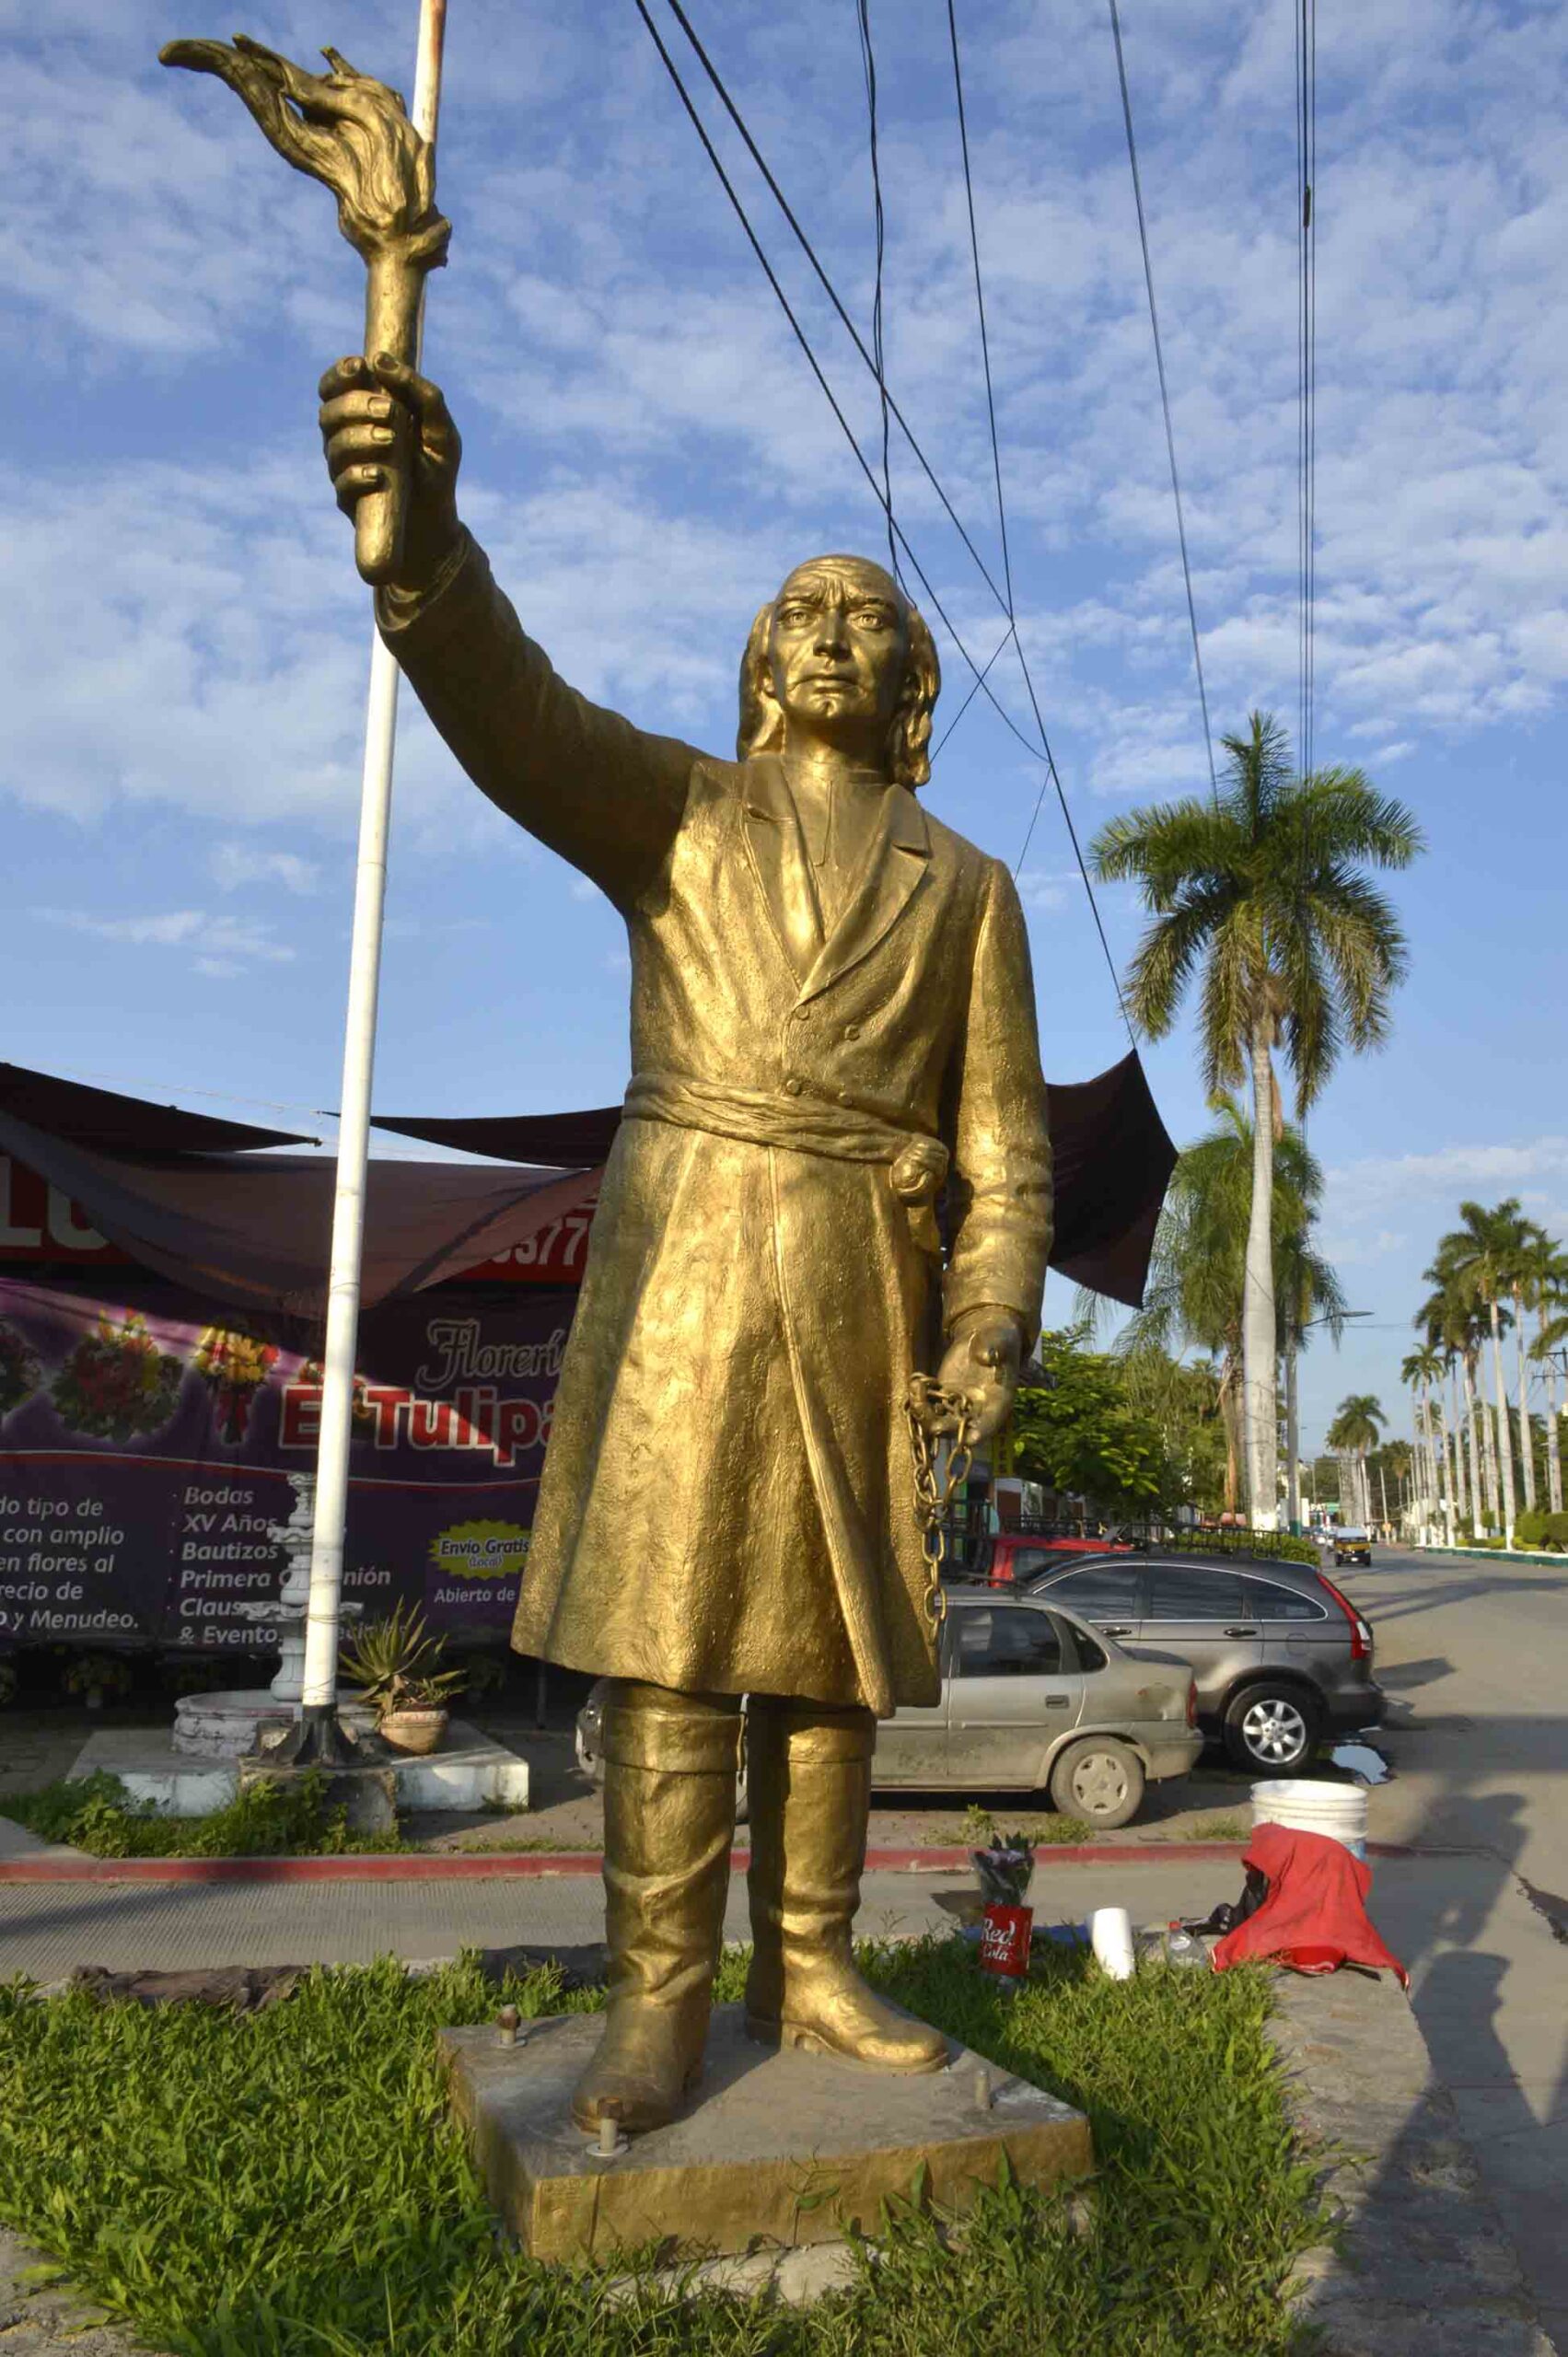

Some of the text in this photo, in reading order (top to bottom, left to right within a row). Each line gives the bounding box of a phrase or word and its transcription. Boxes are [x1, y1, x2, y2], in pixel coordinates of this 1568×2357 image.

[415, 1318, 567, 1391] Florerí
[184, 1485, 254, 1504] Bodas
[27, 1497, 69, 1520] tipo
[76, 1497, 103, 1515] de
[182, 1512, 278, 1532] XV Años
[4, 1525, 125, 1550] con amplio
[484, 1538, 529, 1553] Gratis
[181, 1541, 279, 1561] Bautizos
[28, 1551, 87, 1572] flores
[94, 1553, 114, 1573] al
[180, 1569, 271, 1587] Primera
[55, 1581, 83, 1599] de
[433, 1586, 517, 1603] Abierto de
[12, 1611, 25, 1631] y
[29, 1608, 138, 1629] Menudeo.
[179, 1625, 195, 1644] &
